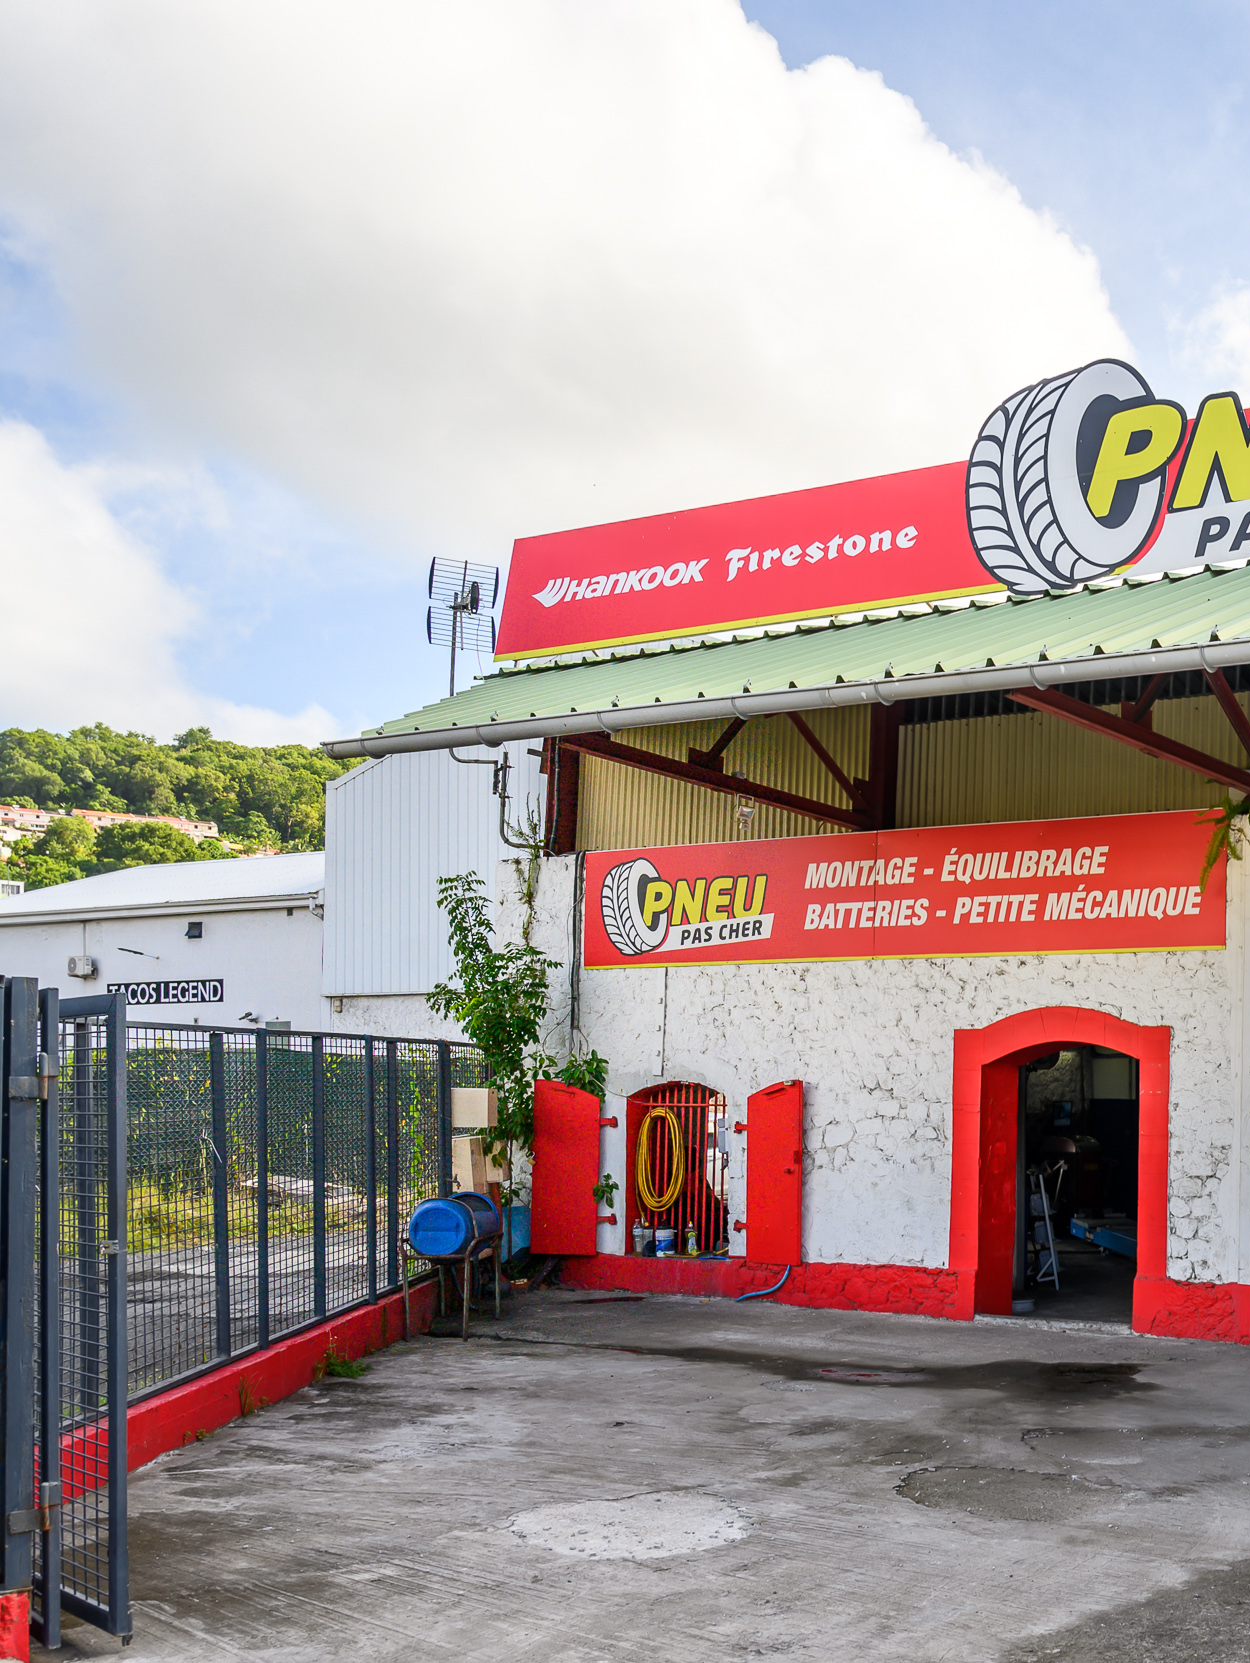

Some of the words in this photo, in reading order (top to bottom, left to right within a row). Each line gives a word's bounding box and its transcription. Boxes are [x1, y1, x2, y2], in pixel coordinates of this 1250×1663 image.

[725, 525, 919, 582] Firestone
[804, 856, 918, 889] MONTAGE
[940, 845, 1110, 885] ÉQUILIBRAGE
[642, 873, 769, 927] PNEU
[803, 898, 930, 930] BATTERIES
[953, 893, 1039, 924] PETITE
[1043, 884, 1203, 921] MÉCANIQUE
[680, 926, 713, 946] PAS
[718, 919, 763, 941] CHER
[160, 981, 222, 1003] LEGEND
